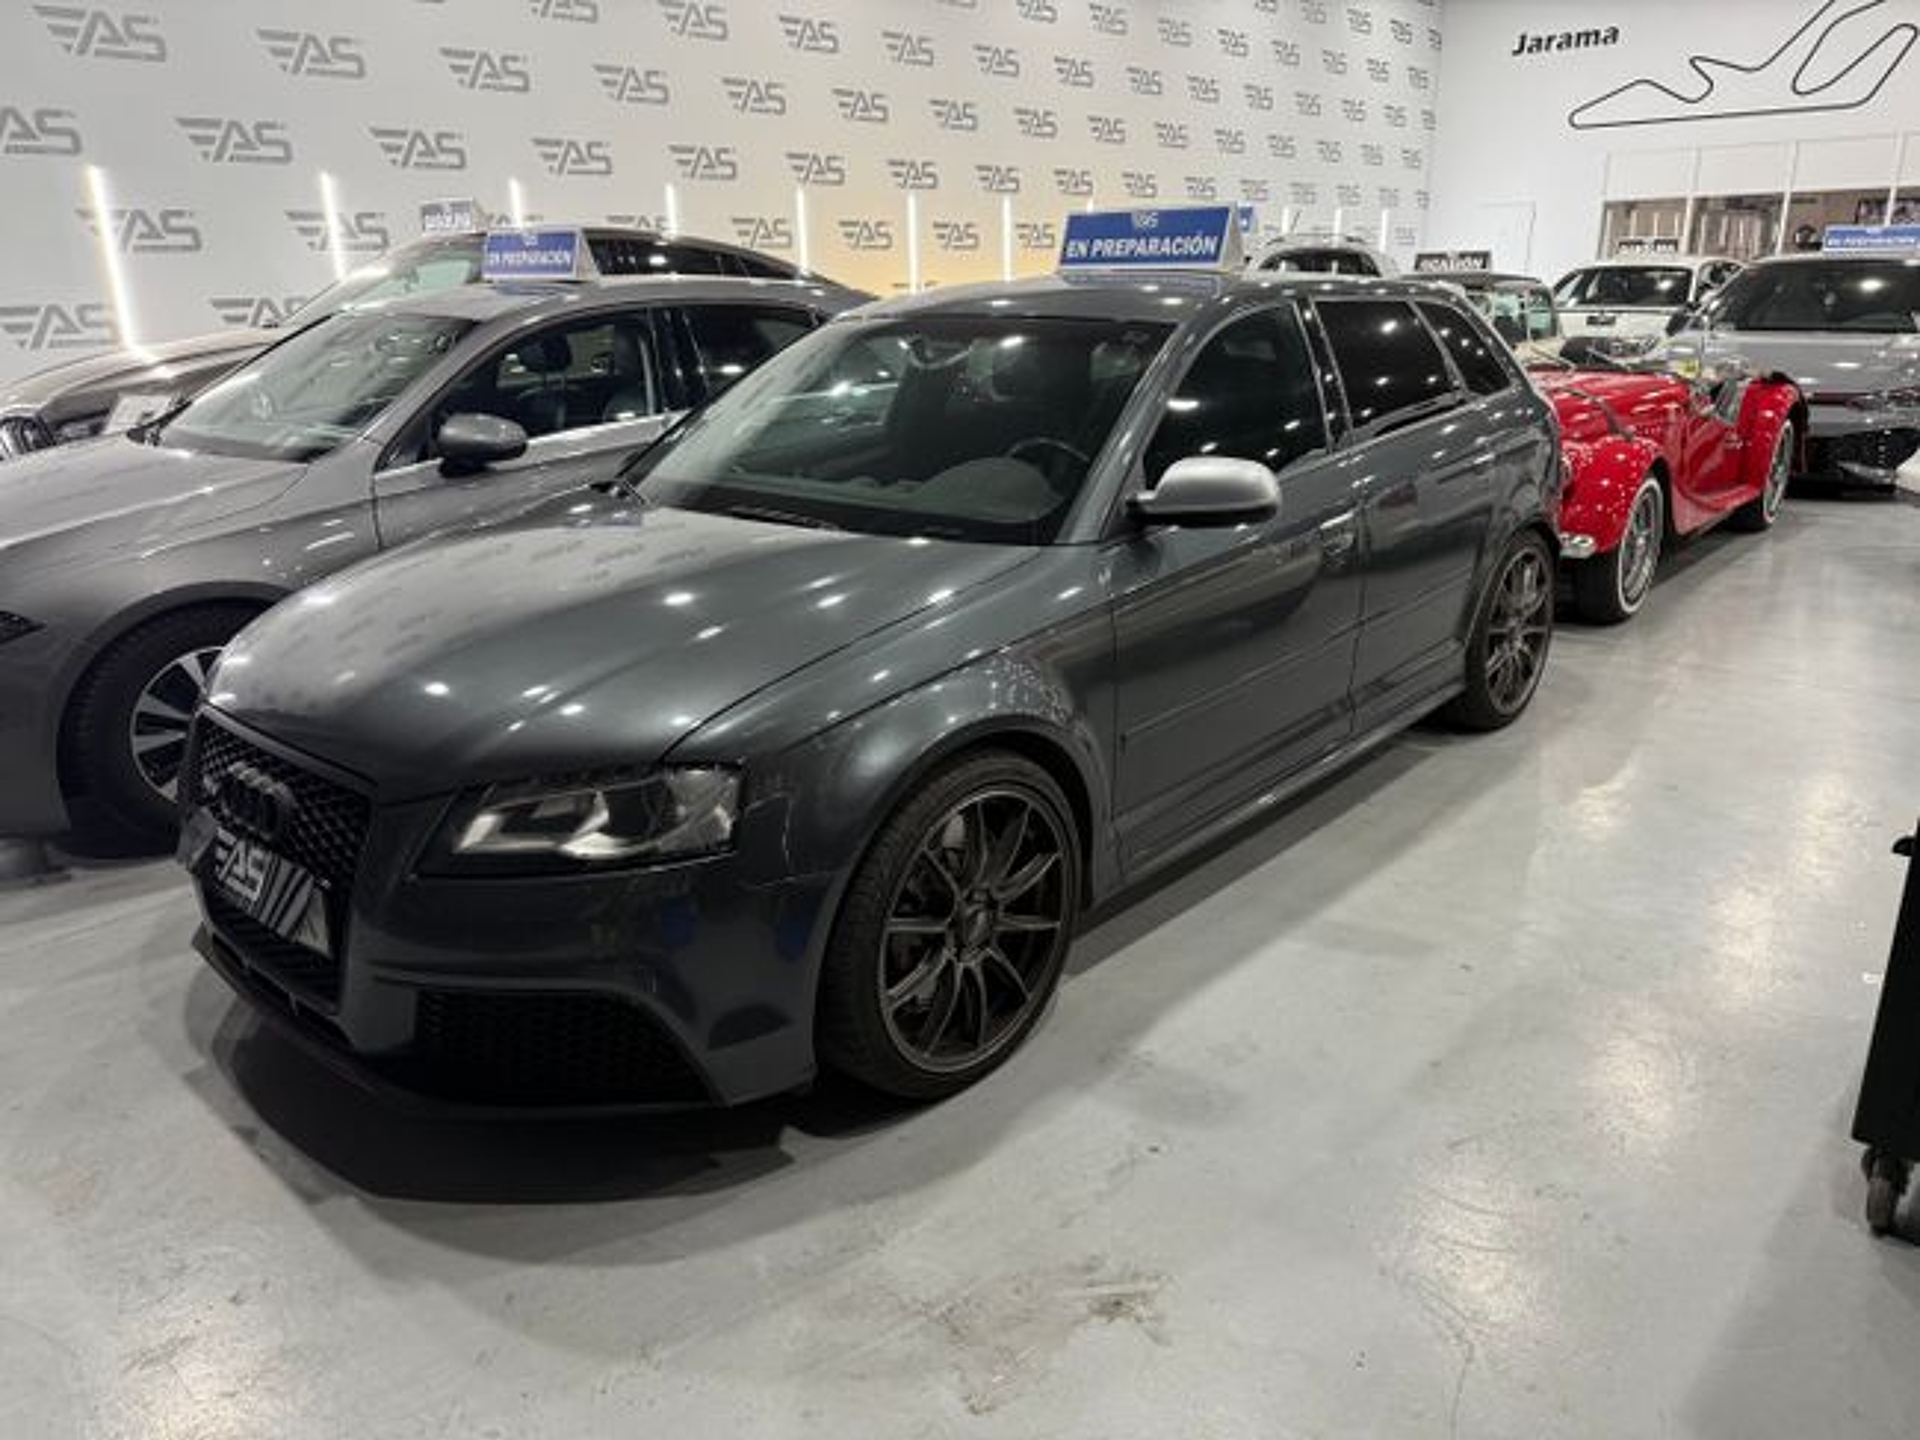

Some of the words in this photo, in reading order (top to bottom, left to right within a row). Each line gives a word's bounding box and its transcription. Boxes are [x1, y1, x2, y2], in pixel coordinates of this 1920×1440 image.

[1512, 26, 1619, 56] Jarama
[1066, 239, 1088, 258] EN
[1091, 231, 1218, 257] PREPARACIÓN
